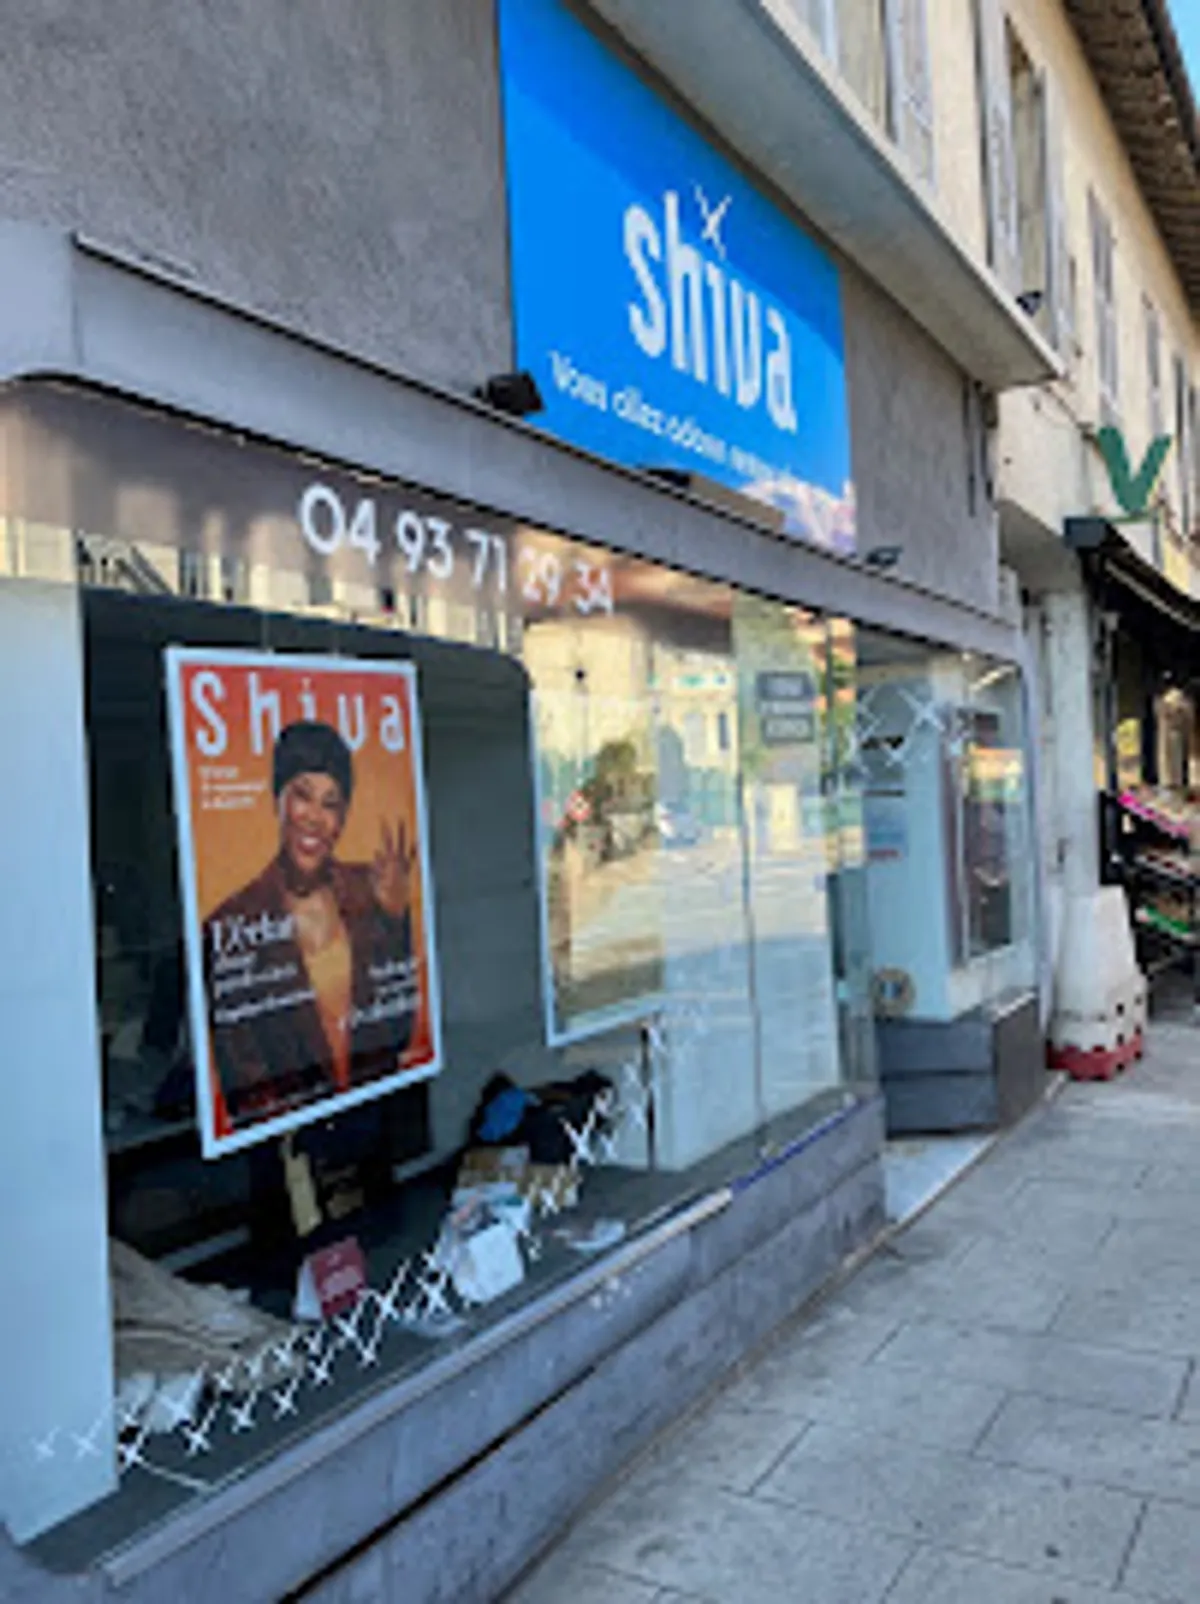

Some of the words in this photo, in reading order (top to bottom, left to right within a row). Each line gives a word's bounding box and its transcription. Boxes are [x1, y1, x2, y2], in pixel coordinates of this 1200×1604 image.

[301, 485, 380, 567] 04
[397, 511, 453, 578] 93
[464, 529, 507, 592] 71
[521, 546, 561, 606] 29
[571, 562, 614, 617] 34
